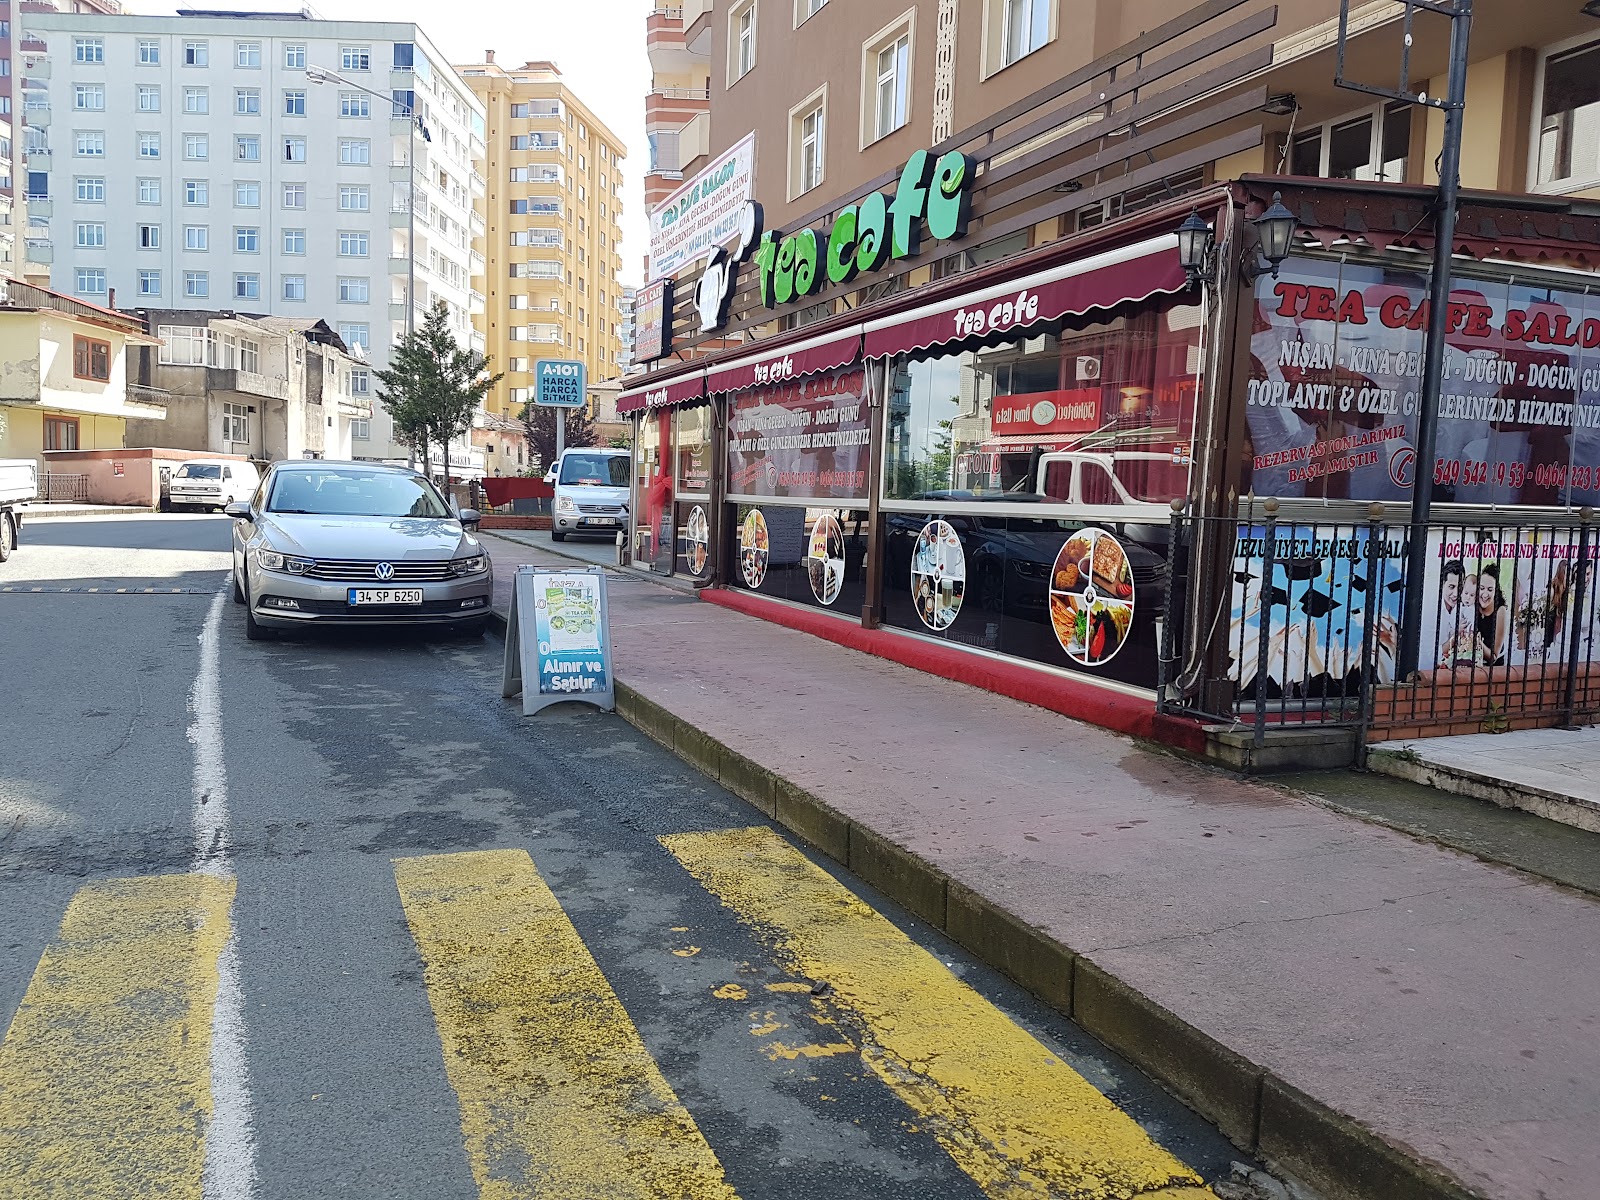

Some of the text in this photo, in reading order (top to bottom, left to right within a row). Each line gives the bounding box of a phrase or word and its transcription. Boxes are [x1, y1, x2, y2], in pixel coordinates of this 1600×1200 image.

[754, 149, 976, 310] tea cafe
[953, 290, 1039, 336] tea cafe
[1273, 282, 1369, 325] TEA
[1379, 295, 1493, 338] CAFE
[754, 355, 793, 382] tea cafe
[1278, 334, 1335, 375] NİŞAN
[1349, 346, 1391, 375] KINA
[1463, 352, 1517, 385] DÜĞÜN
[1527, 359, 1579, 391] DOĞUM
[543, 377, 578, 387] HARCA
[543, 385, 578, 395] HARCA
[736, 372, 866, 410] TEA CAFE SALON
[1247, 379, 1335, 411] TOPLANTI
[1339, 386, 1355, 412] &
[1357, 383, 1399, 415] ÖZEL
[1288, 450, 1379, 483] BAŞLAMIŞTIR
[1462, 460, 1488, 486] 542
[1508, 461, 1525, 488] 53
[358, 590, 420, 602] 34 SP 6250
[585, 661, 602, 673] ve
